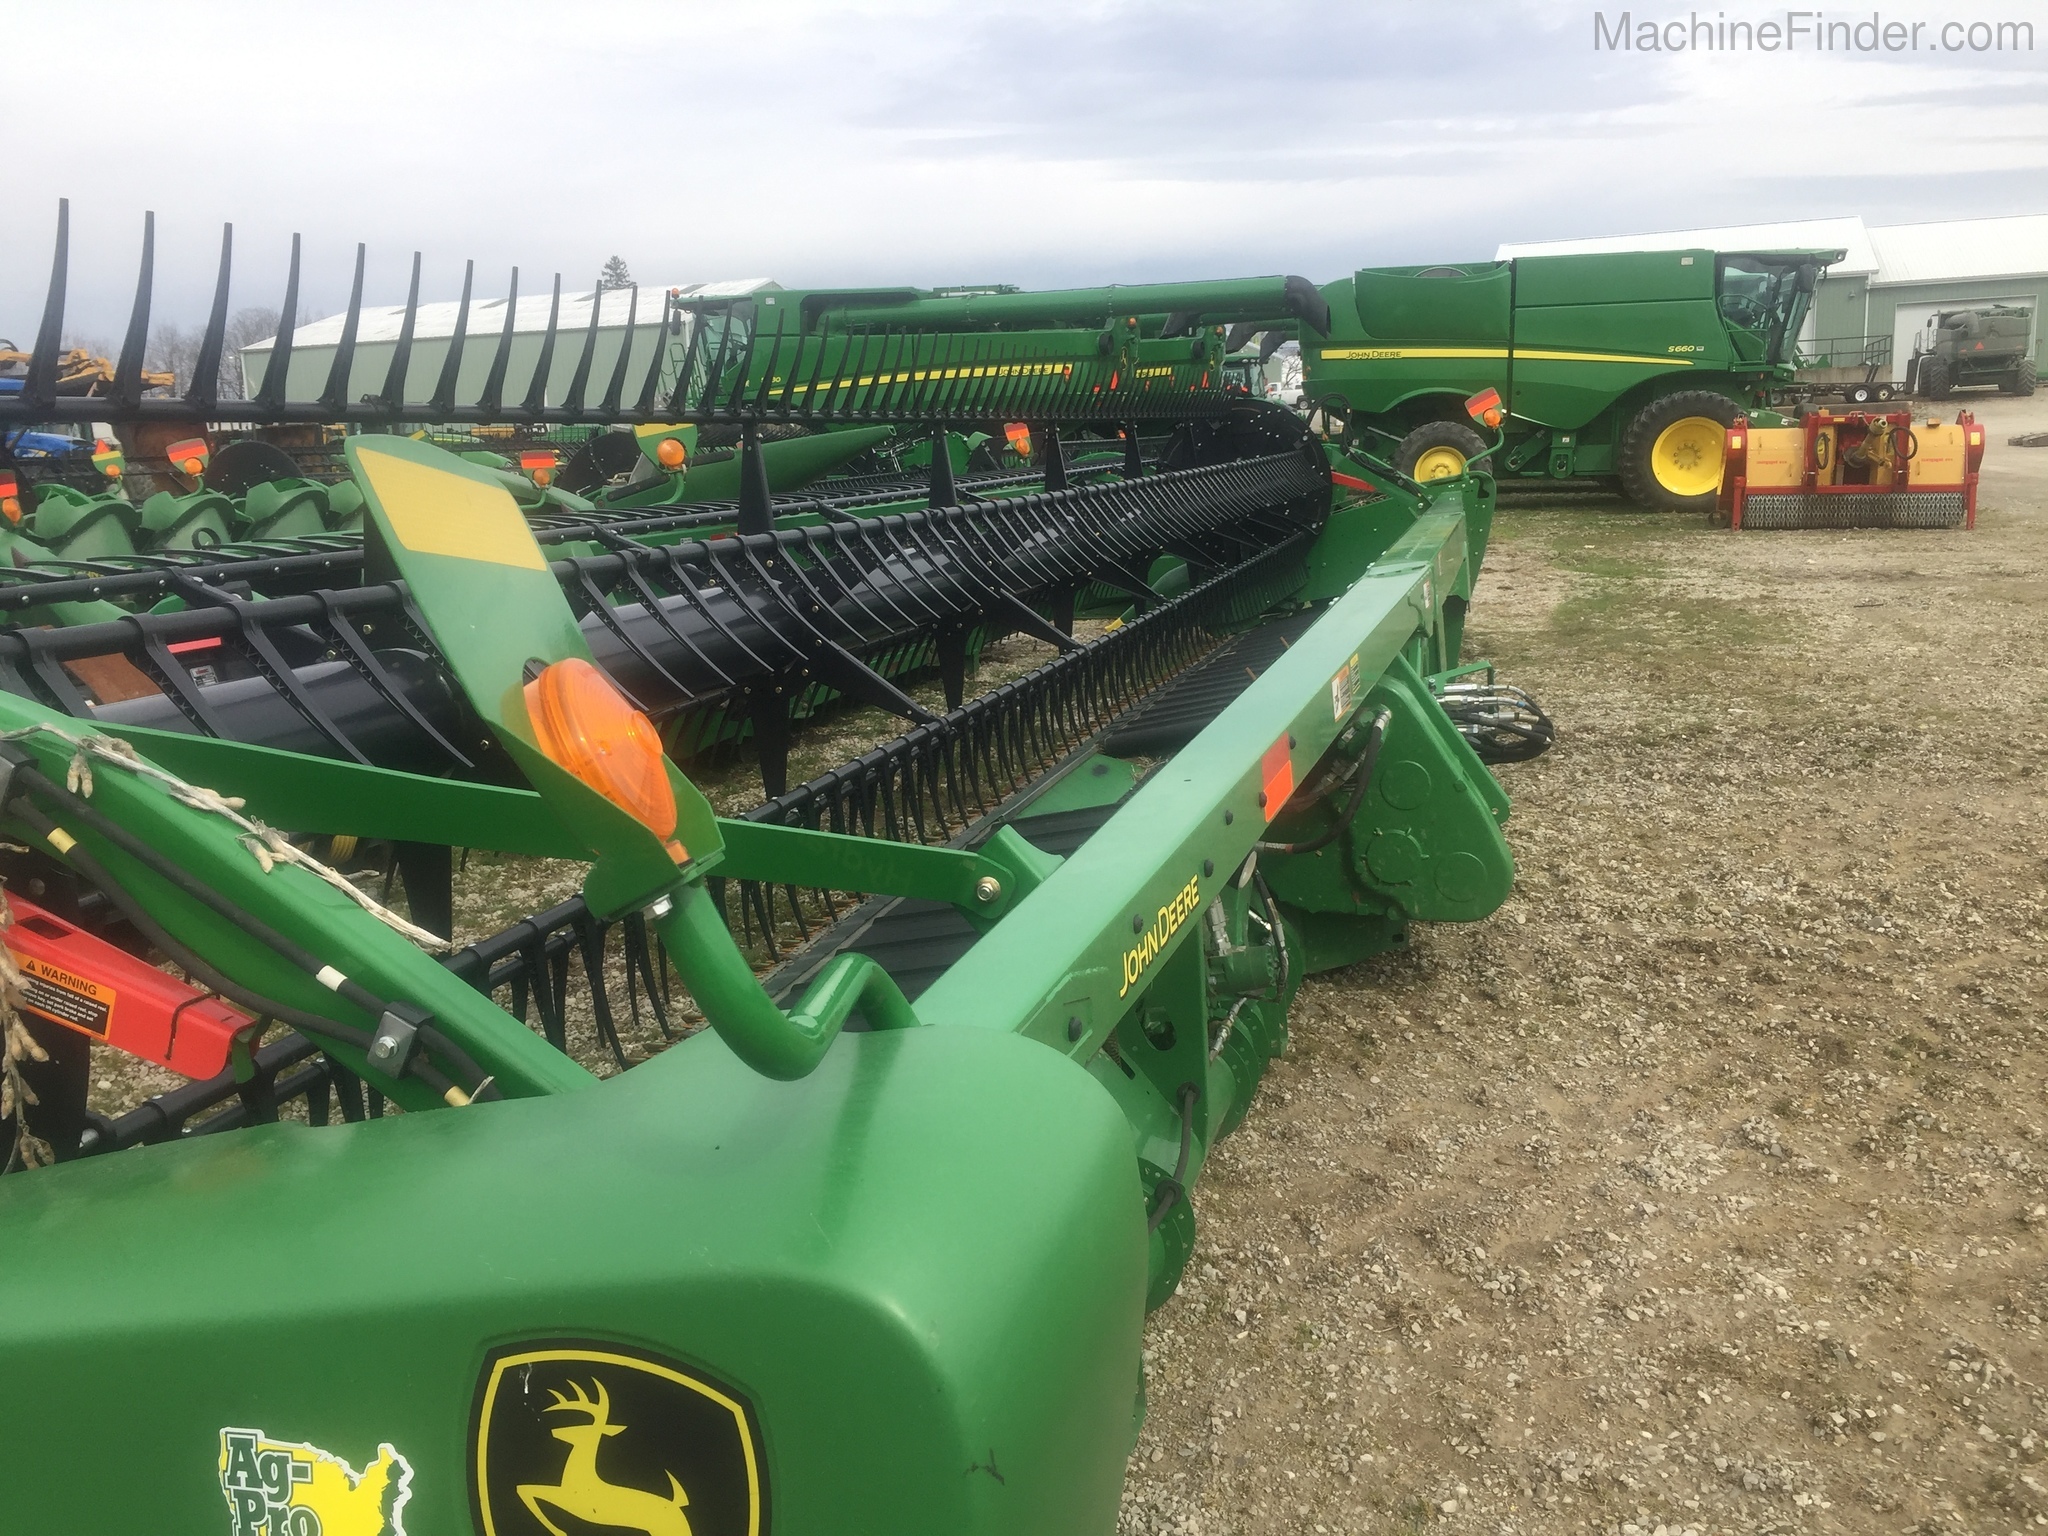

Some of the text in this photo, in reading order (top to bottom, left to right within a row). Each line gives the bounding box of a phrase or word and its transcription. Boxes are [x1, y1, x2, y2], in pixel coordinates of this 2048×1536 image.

[1346, 350, 1370, 358] JOHN
[1667, 345, 1695, 353] S660
[1119, 873, 1200, 998] JOHN DEERE
[41, 964, 97, 996] WARNING
[225, 1432, 314, 1505] Ag-
[232, 1488, 323, 1536] Pro
